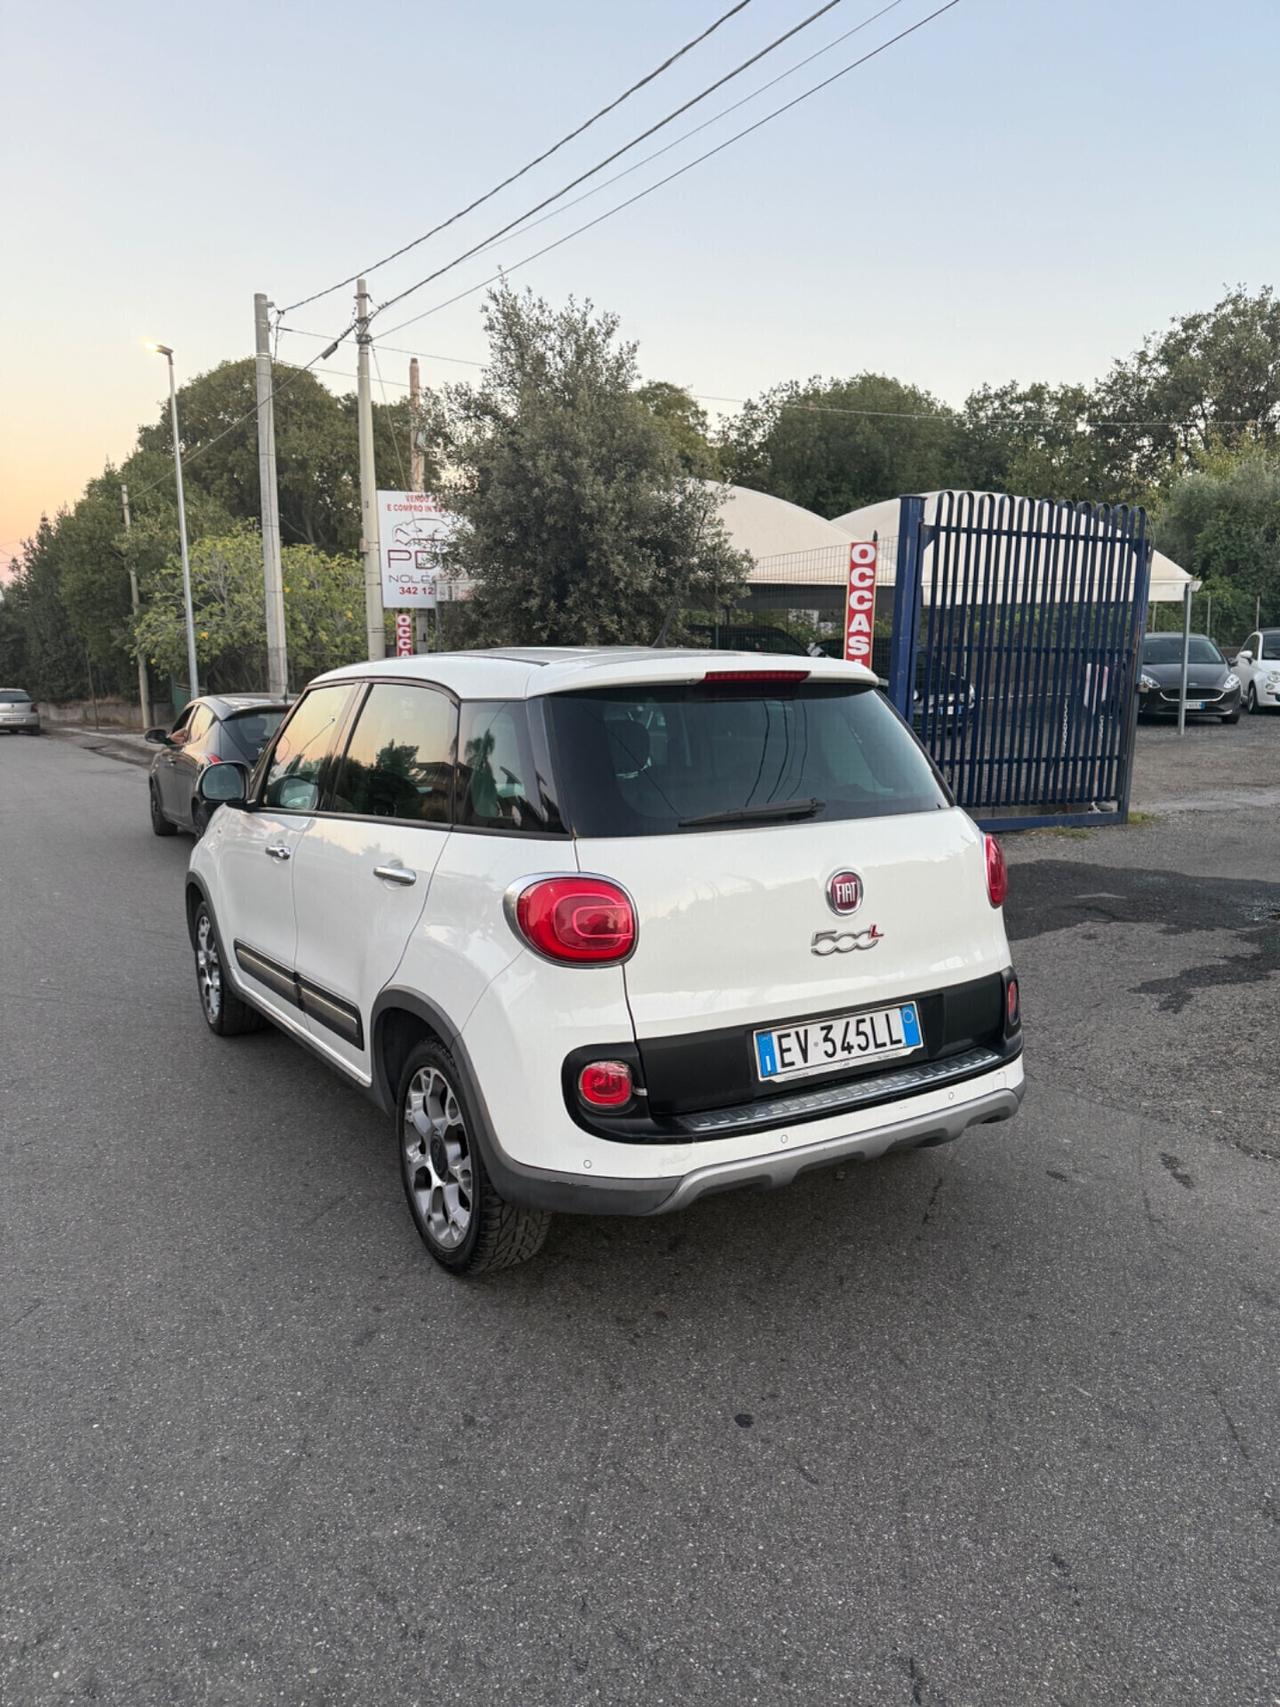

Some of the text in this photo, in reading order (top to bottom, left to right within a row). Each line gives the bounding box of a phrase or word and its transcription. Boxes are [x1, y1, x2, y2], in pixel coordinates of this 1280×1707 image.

[393, 504, 423, 512] COMPRO
[399, 586, 418, 595] 342
[848, 543, 876, 664] OCCAS
[835, 882, 857, 904] FIAT
[811, 924, 884, 956] 500L
[777, 1029, 808, 1069] EV
[820, 1013, 902, 1058] 345LL
